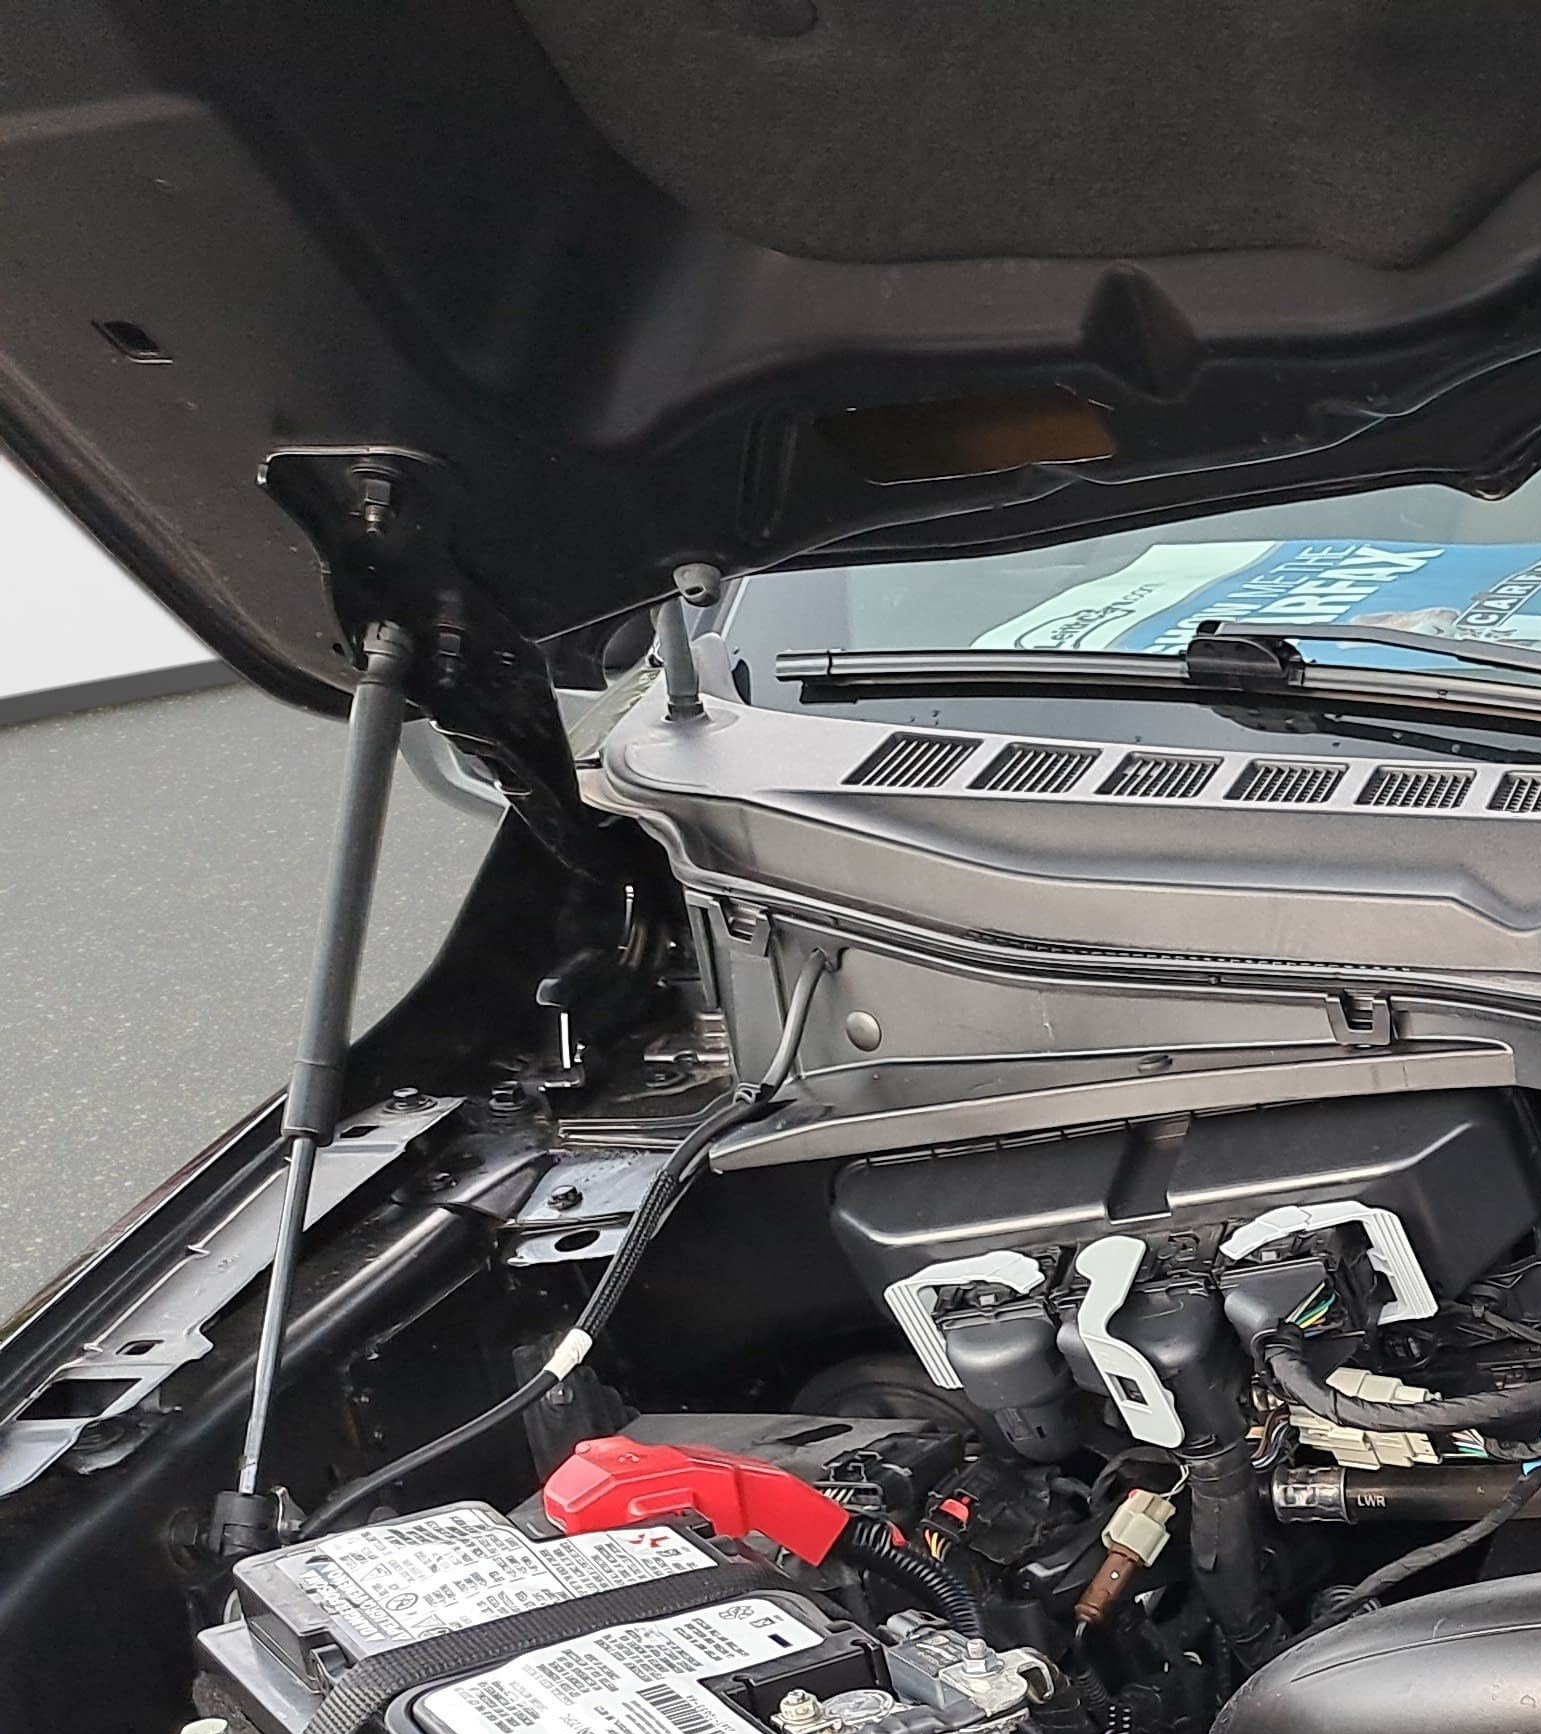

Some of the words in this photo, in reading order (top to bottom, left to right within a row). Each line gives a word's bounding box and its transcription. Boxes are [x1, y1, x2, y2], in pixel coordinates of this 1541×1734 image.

[1227, 575, 1310, 598] ME
[1270, 545, 1355, 573] THE
[1357, 1494, 1386, 1507] LWR
